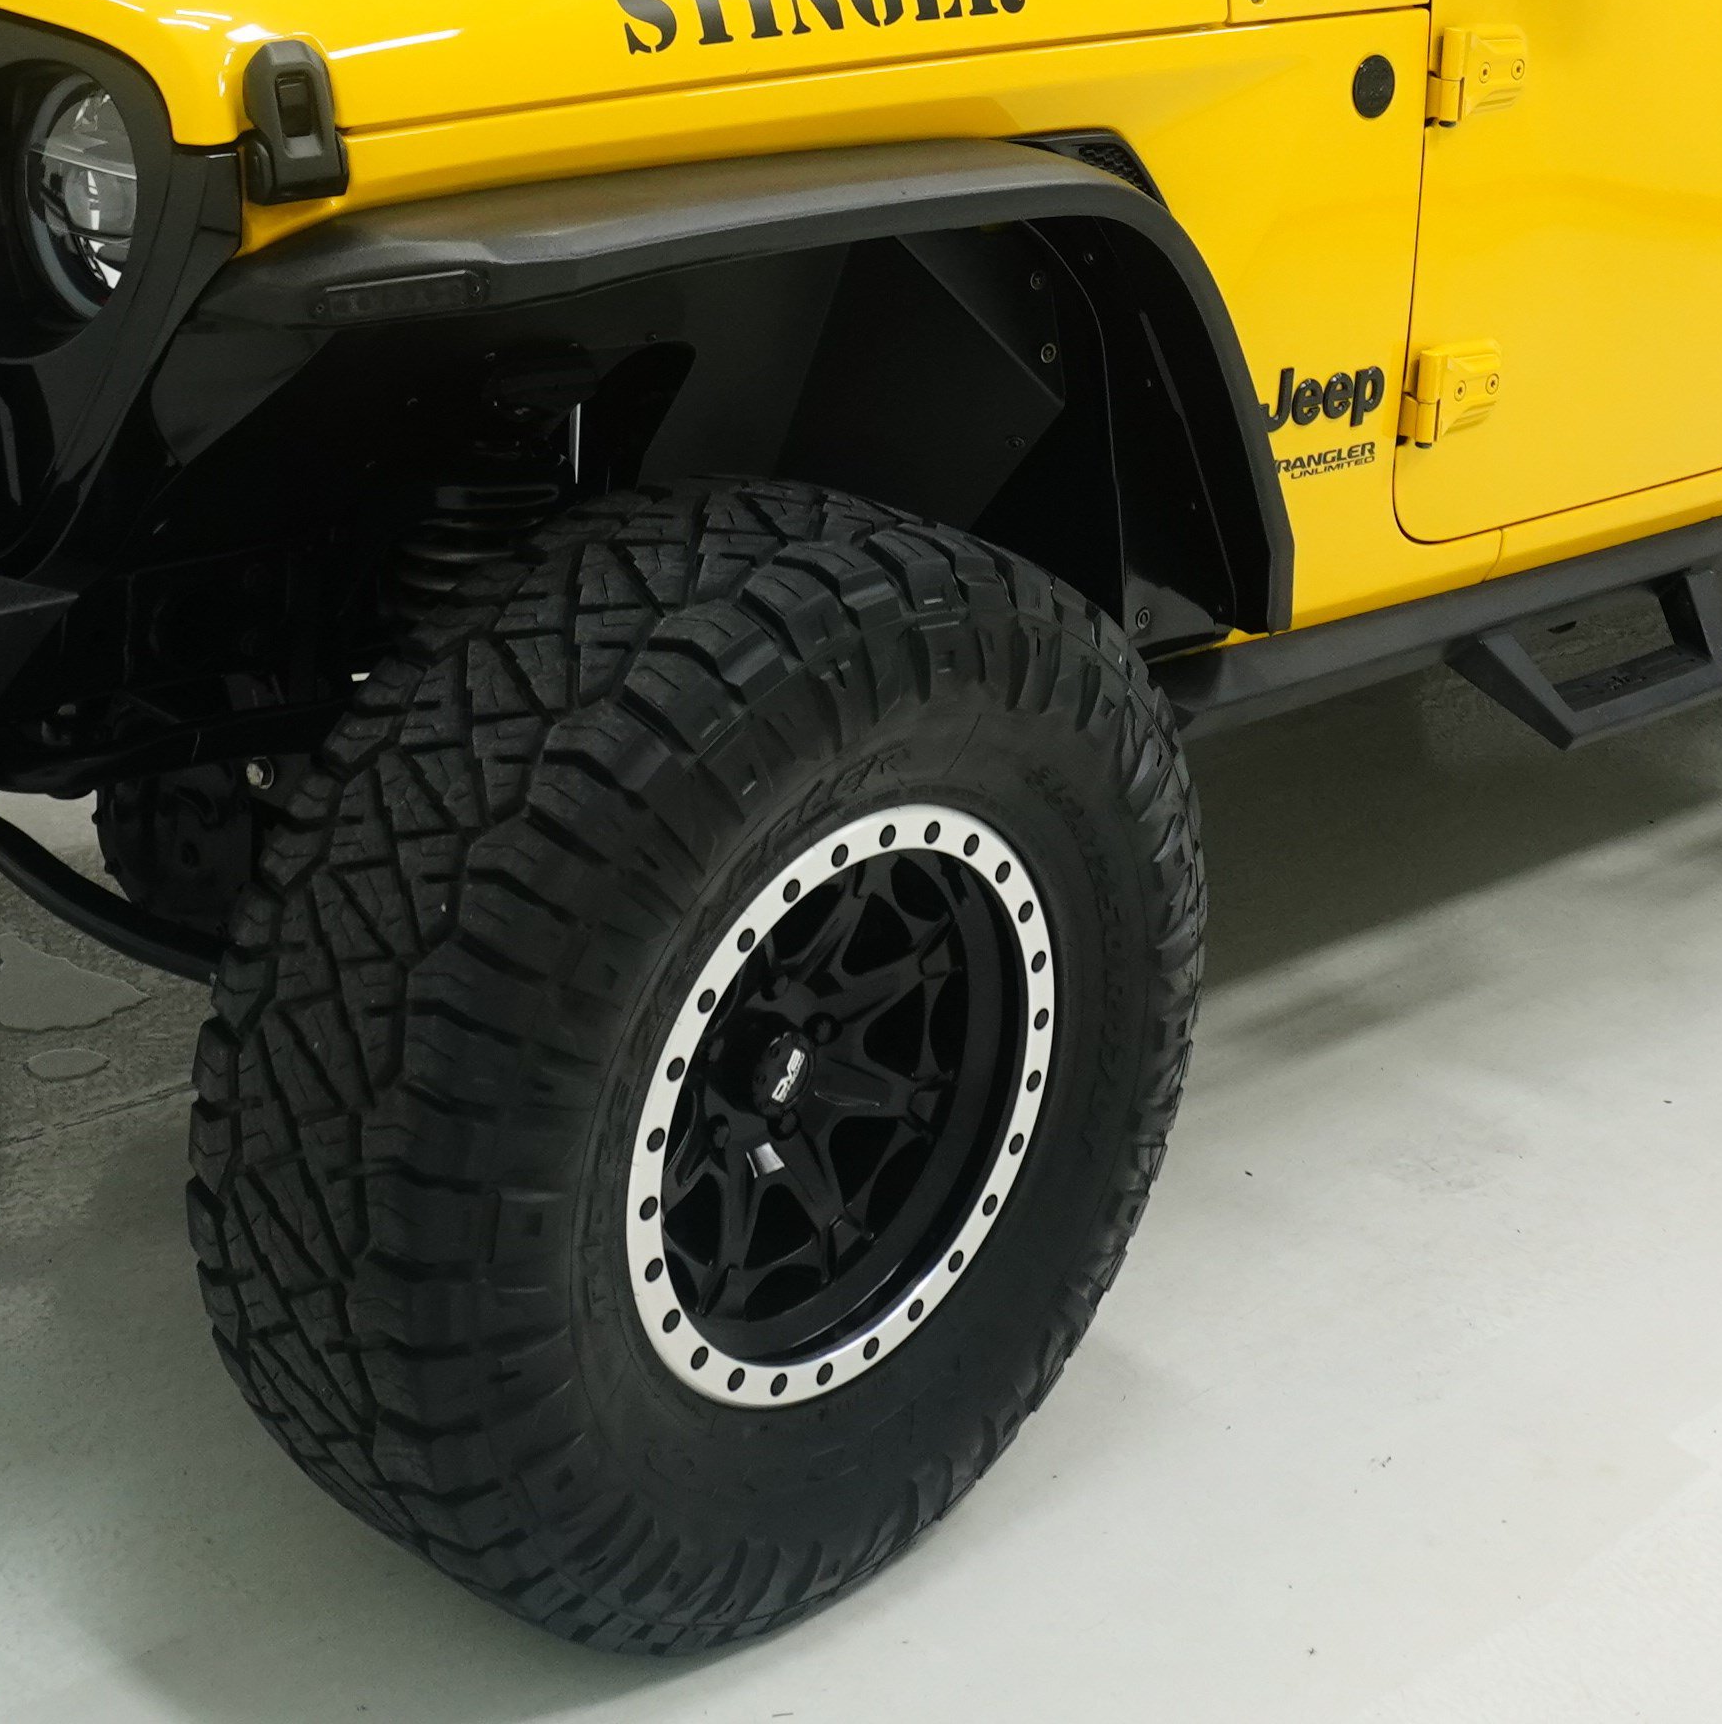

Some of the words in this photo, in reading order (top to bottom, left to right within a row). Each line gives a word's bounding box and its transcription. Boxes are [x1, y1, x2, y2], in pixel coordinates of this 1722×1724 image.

[1259, 366, 1385, 433] Jeep
[1274, 441, 1376, 475] RANGLER
[1290, 455, 1375, 479] UNLIMITED
